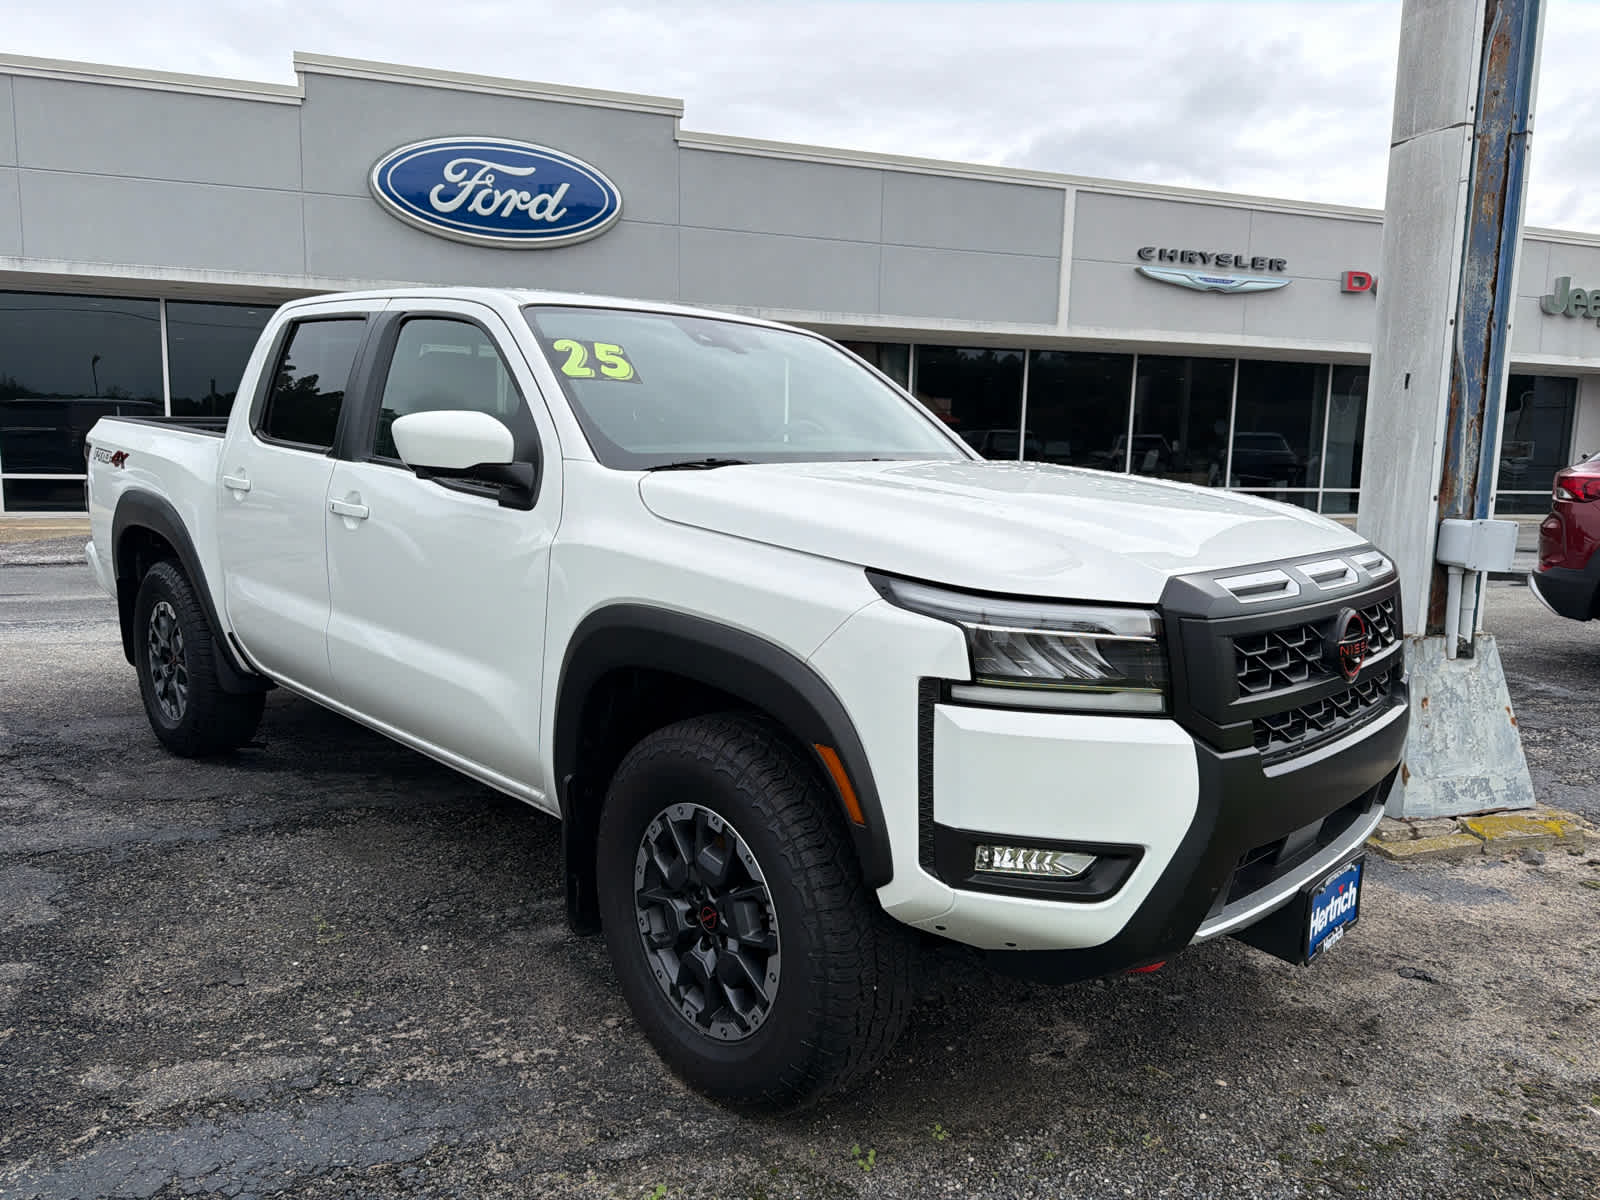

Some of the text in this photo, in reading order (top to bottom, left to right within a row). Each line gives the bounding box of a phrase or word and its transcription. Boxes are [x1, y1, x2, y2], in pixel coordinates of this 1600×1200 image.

[429, 158, 570, 222] Ford
[1137, 246, 1288, 272] CHRYSLER
[553, 339, 634, 380] 25
[1310, 881, 1357, 941] Hertrich
